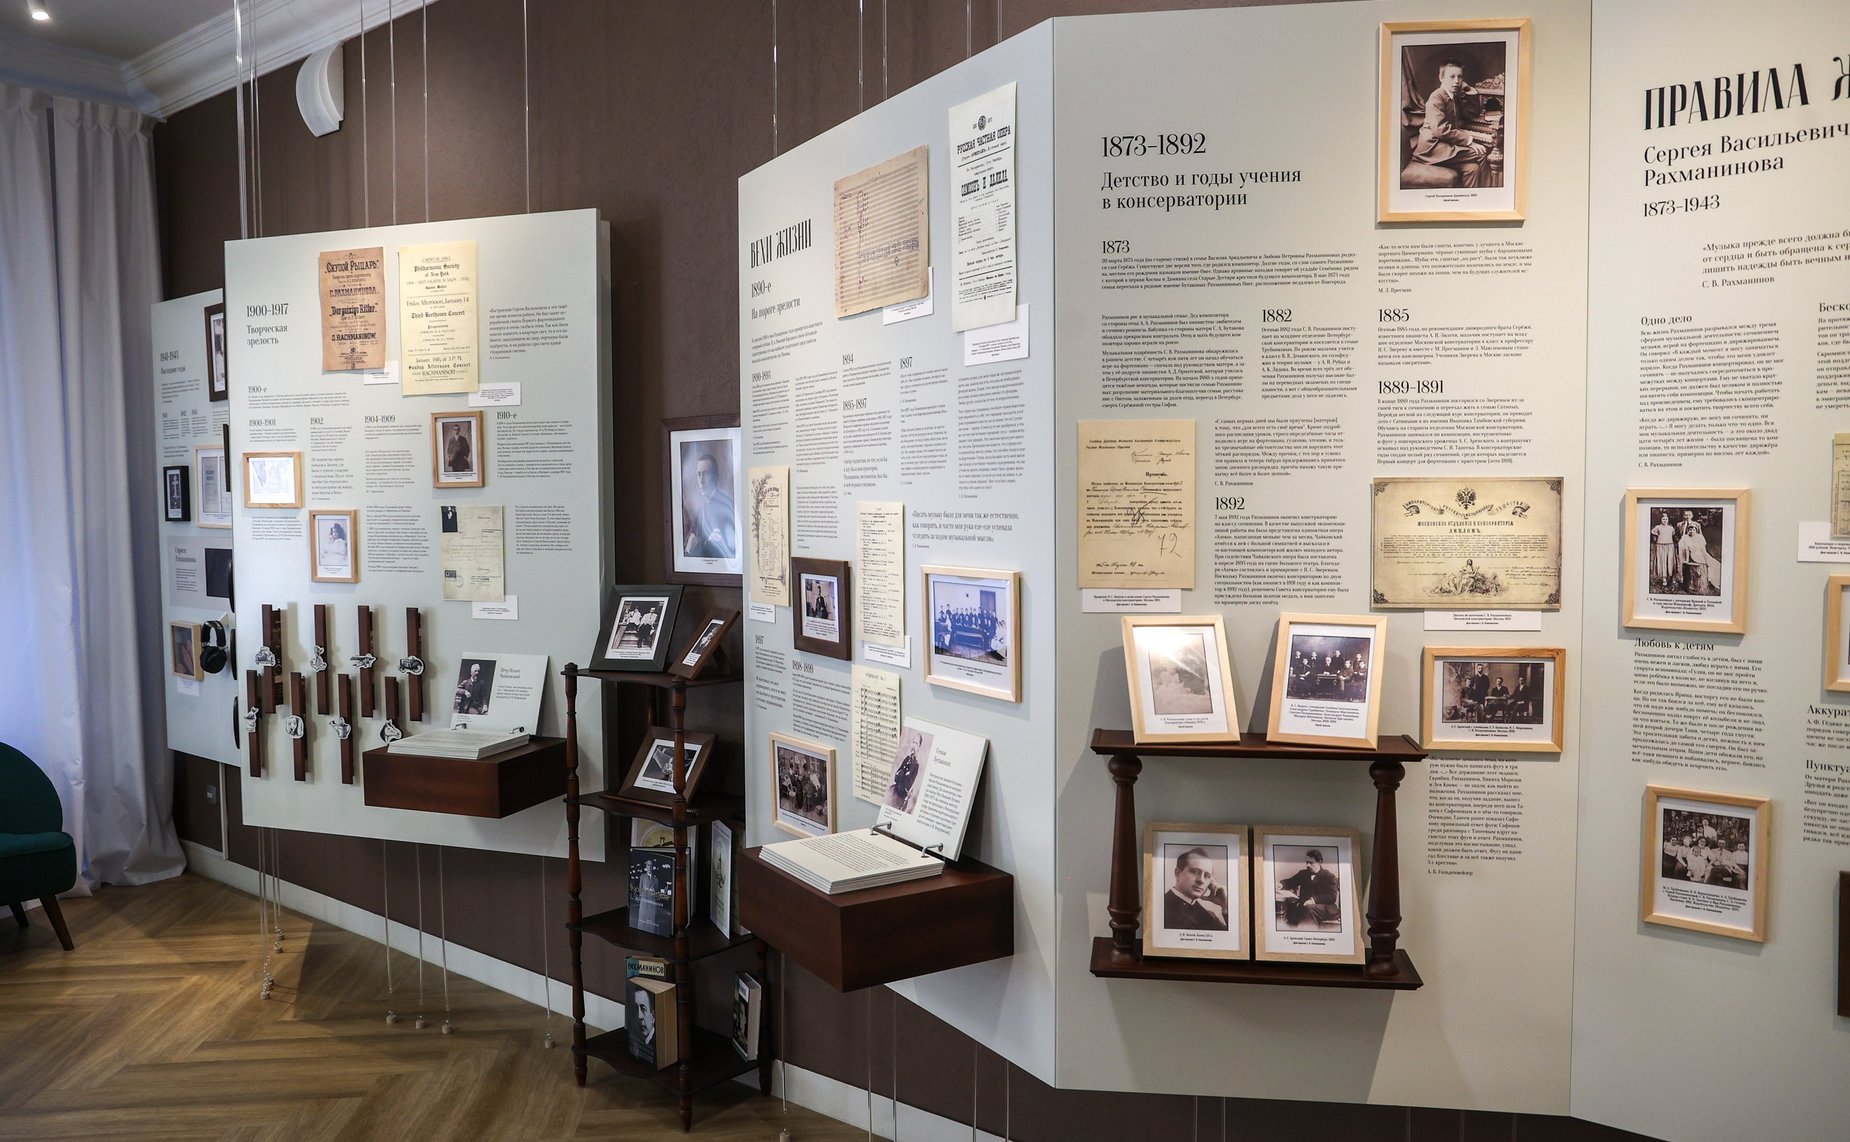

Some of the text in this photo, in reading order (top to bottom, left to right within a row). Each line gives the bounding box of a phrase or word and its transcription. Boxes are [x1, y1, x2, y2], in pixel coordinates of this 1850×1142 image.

[1645, 64, 1809, 130] ПРАВИЛА
[1645, 144, 1711, 164] Сергея
[1646, 158, 1783, 186] Рахманинова
[1101, 171, 1301, 191] Детство и годы учения
[1103, 194, 1247, 212] в консерватории
[751, 220, 812, 268] ВЕХИ ЖИЗНИ
[1103, 240, 1130, 254] 1873
[1743, 240, 1776, 248] прежде
[1805, 233, 1840, 242] должна
[1780, 246, 1825, 256] обращена
[1738, 262, 1778, 270] надежды
[1805, 256, 1842, 264] вечным
[752, 280, 772, 298] 1890-е
[1722, 278, 1775, 286] Рахманинов
[752, 298, 800, 320] На пороге зрелости
[1263, 309, 1292, 323] 1882
[1380, 309, 1410, 322] 1885
[1641, 316, 1692, 326] Одно дело
[247, 325, 288, 334] Творческая
[247, 334, 279, 348] зрелость
[843, 354, 854, 365] 1894
[900, 357, 913, 369] 1897
[497, 412, 518, 420] 1910-е
[1216, 497, 1245, 510] 1892
[756, 635, 764, 644] 1897
[1634, 638, 1671, 648] Любовь
